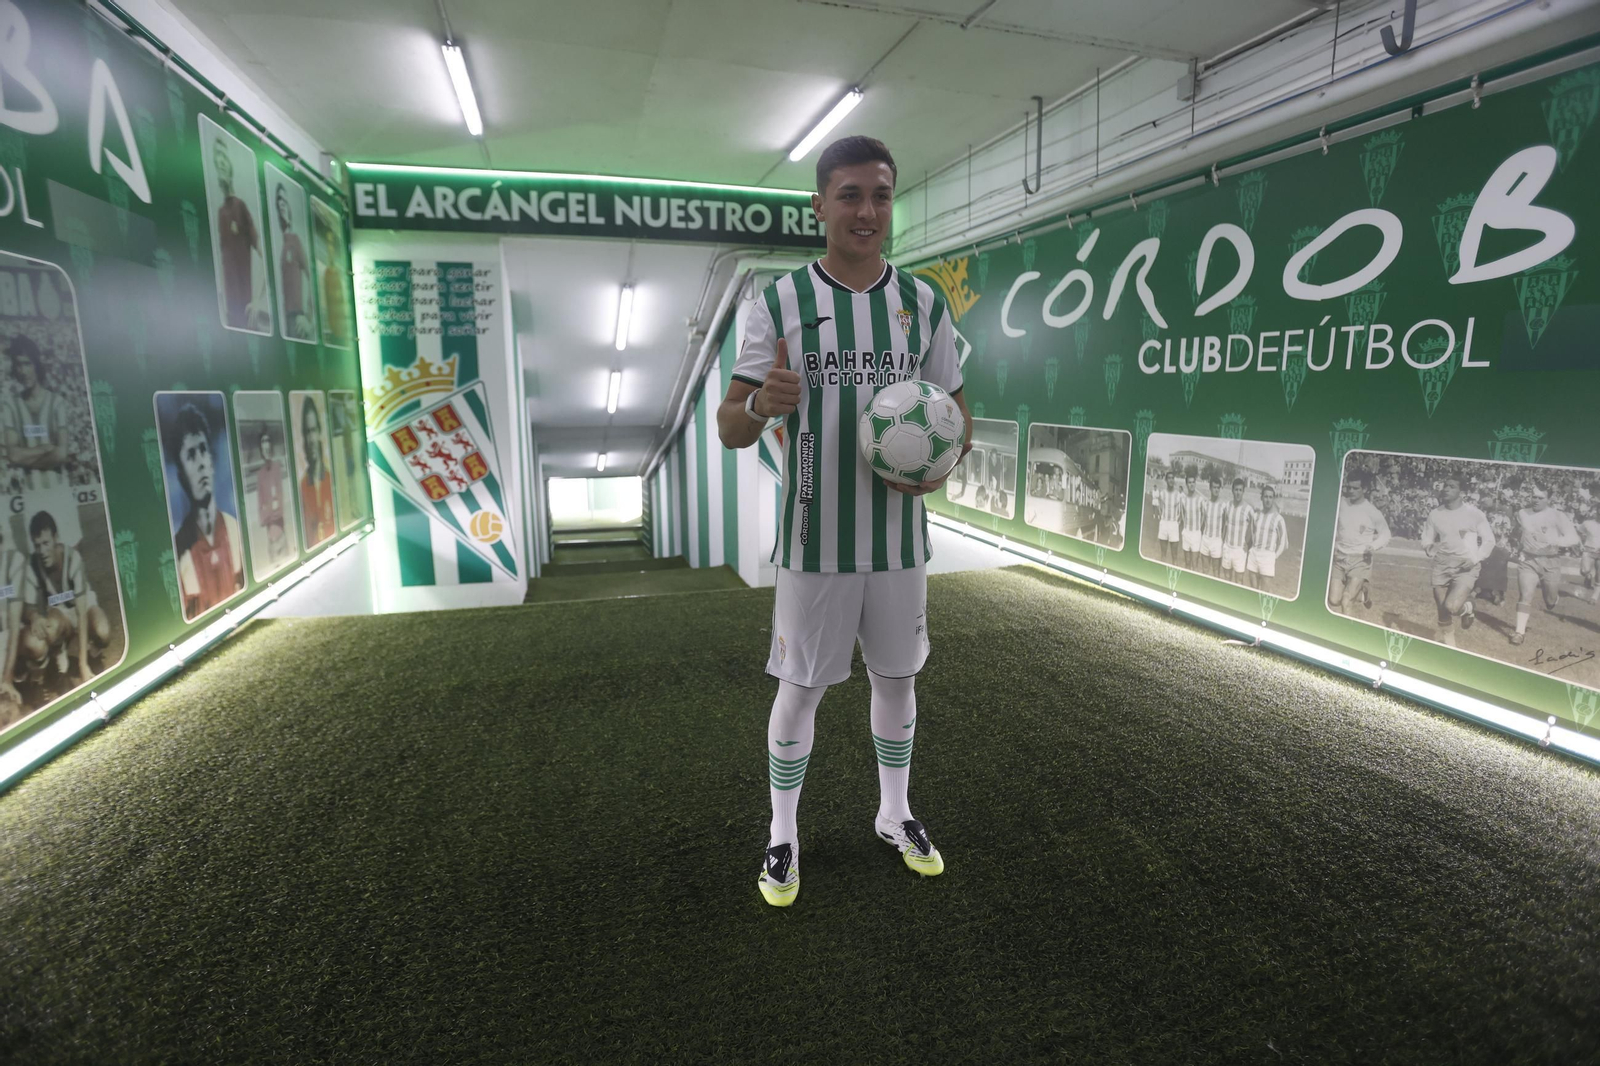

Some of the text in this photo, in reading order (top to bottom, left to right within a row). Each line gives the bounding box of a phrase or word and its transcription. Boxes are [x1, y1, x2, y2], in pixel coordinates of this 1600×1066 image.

[353, 182, 399, 218] EL
[404, 180, 606, 225] ARCÁNGEL
[614, 194, 773, 234] NUESTRO
[1000, 145, 1576, 338] CÓRDOB
[804, 350, 919, 373] BAHRAIN
[1138, 316, 1490, 375] CLUBDEFÚTBOL
[807, 433, 815, 499] HUMANIDAD
